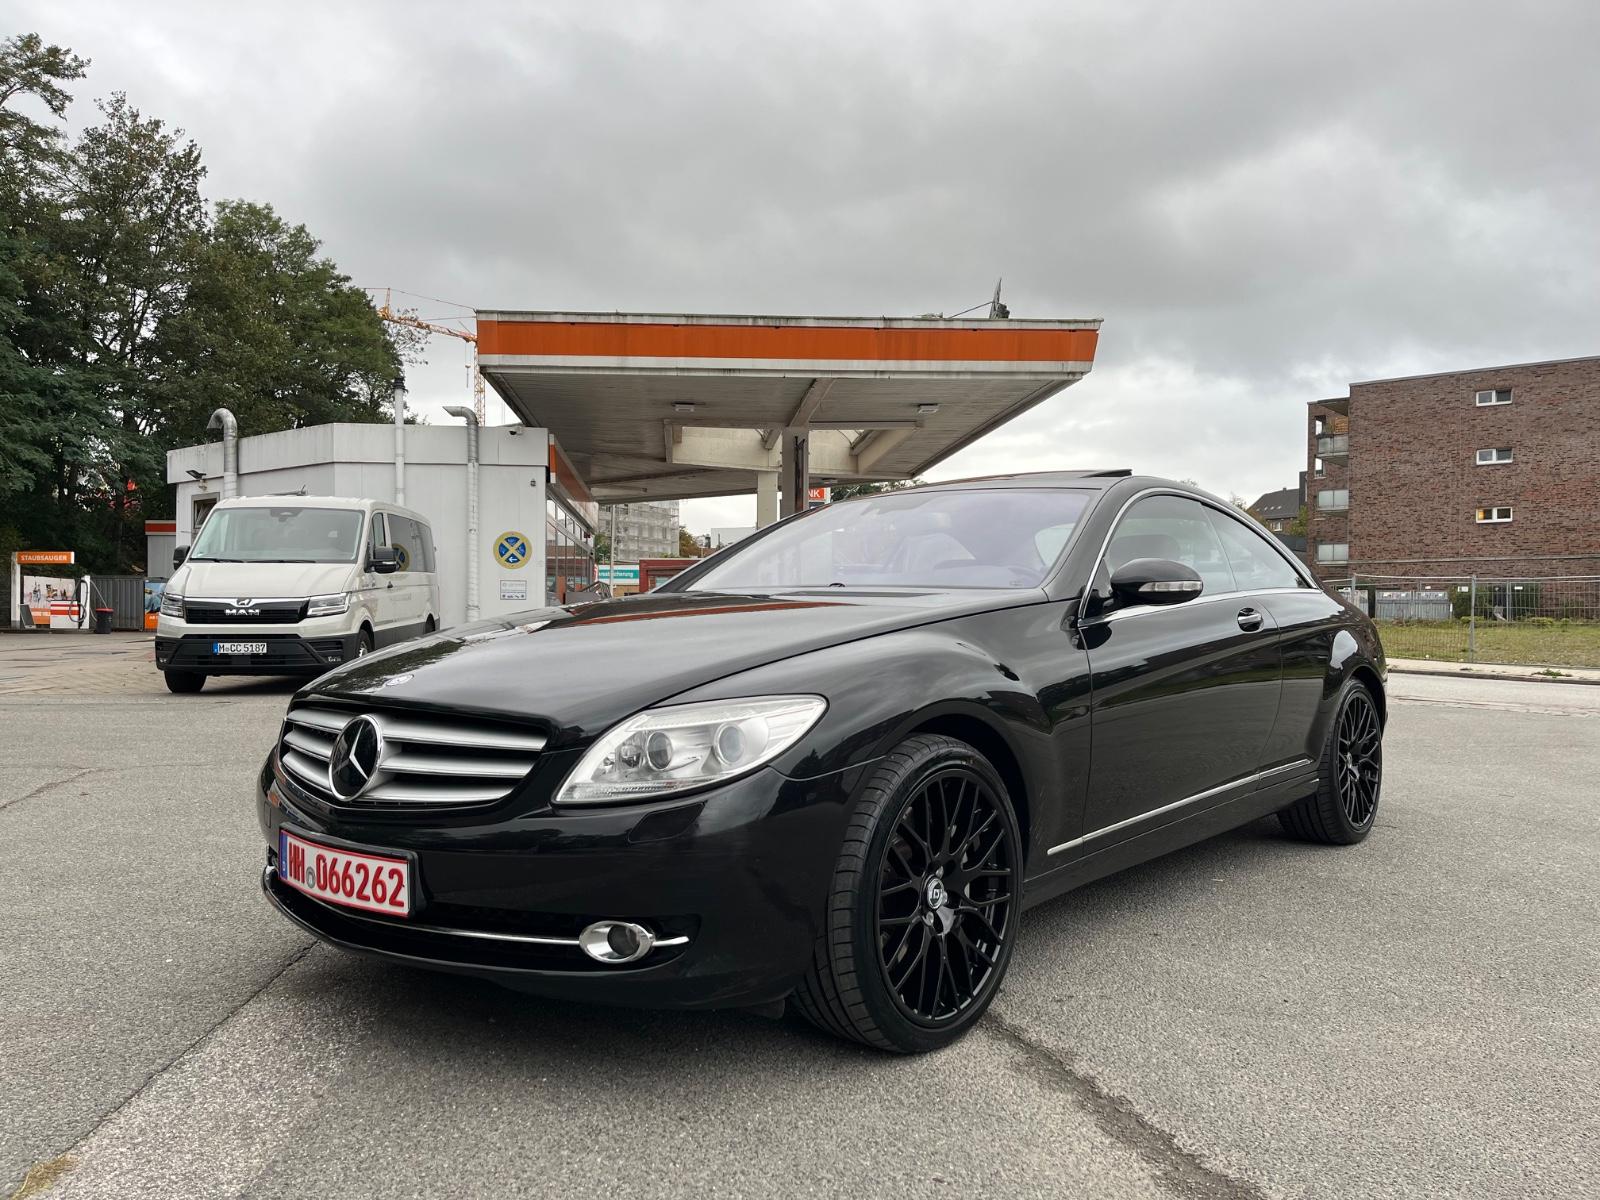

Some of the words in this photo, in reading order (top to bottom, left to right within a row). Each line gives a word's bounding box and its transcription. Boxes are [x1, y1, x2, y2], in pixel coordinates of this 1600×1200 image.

[225, 608, 260, 616] MAN
[219, 643, 225, 653] M
[230, 643, 242, 653] CC
[244, 643, 266, 653] 5187
[288, 841, 305, 884] HH
[315, 853, 405, 908] 066262
